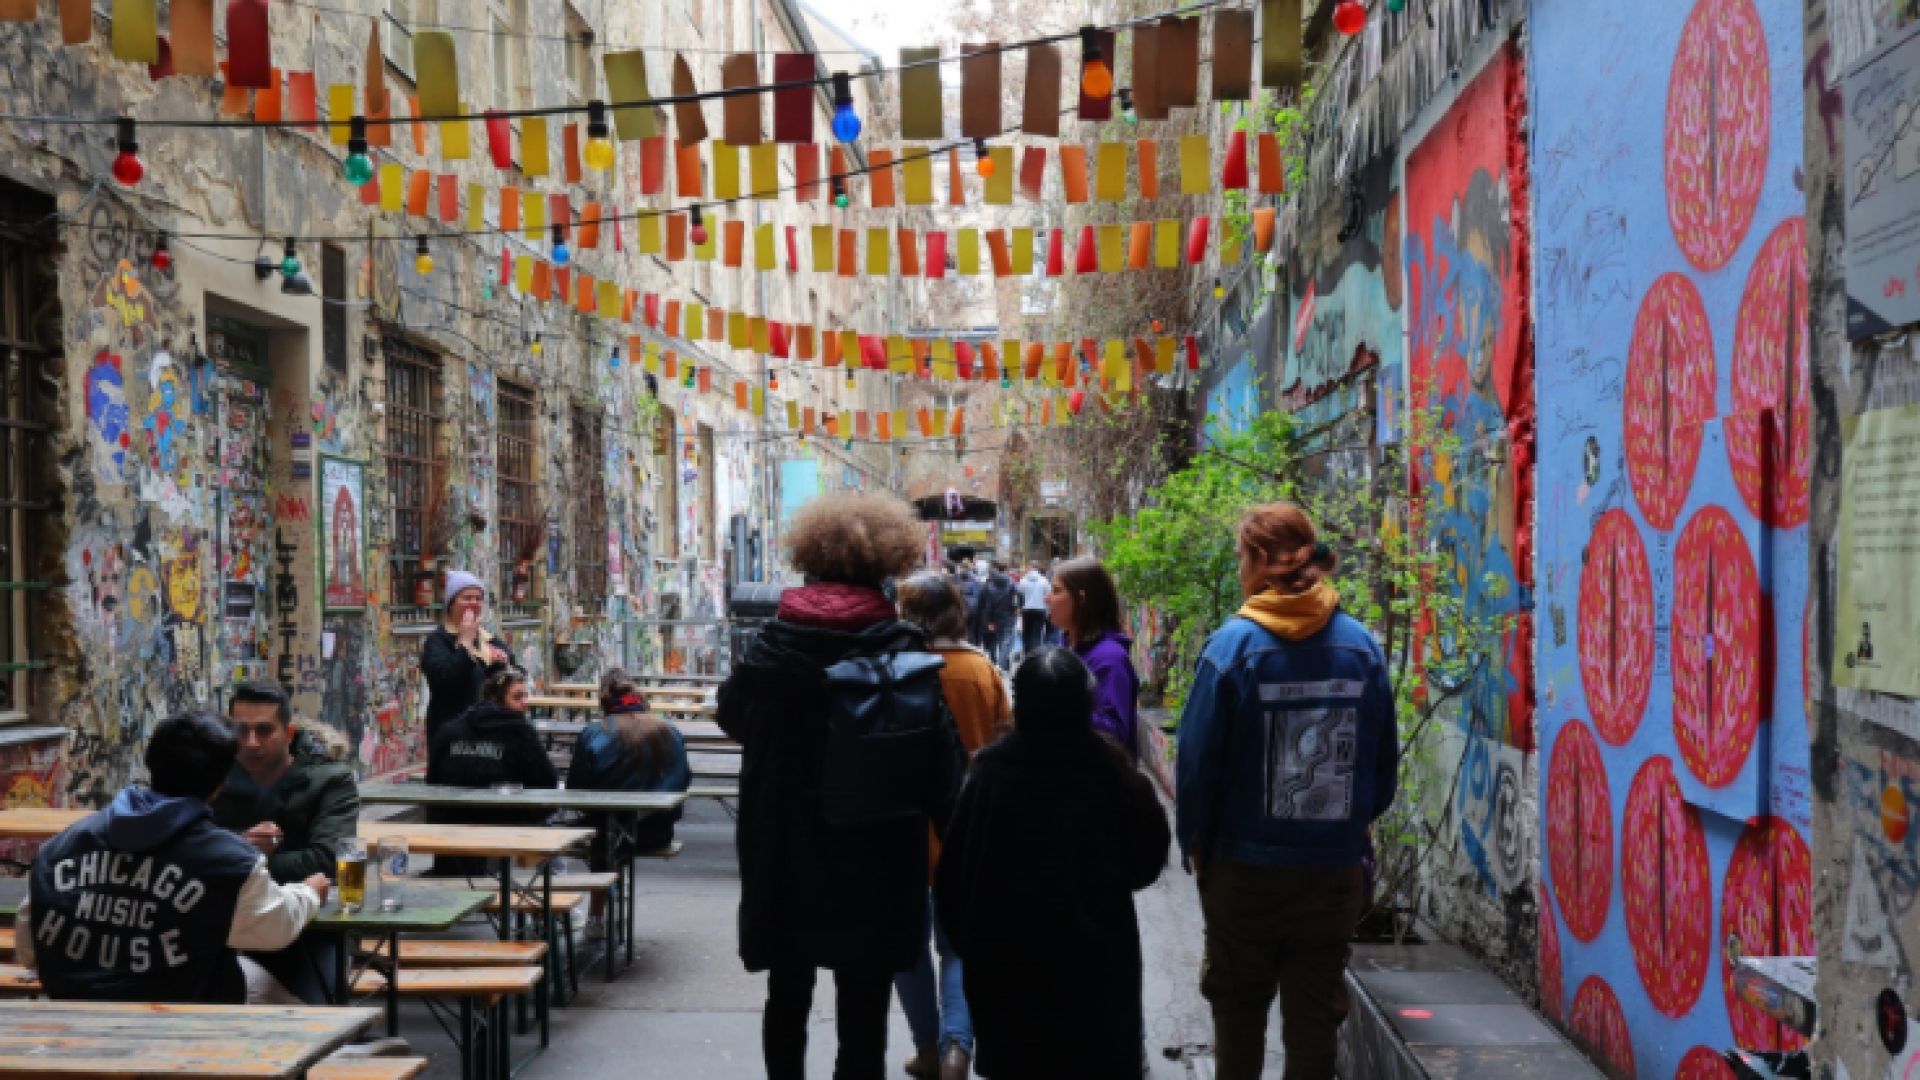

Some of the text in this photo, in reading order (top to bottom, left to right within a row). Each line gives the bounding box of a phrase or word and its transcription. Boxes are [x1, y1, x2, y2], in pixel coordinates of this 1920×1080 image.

[54, 850, 206, 913] CHICAGO
[75, 890, 157, 930] MUSIC
[37, 909, 188, 973] HOUSE
